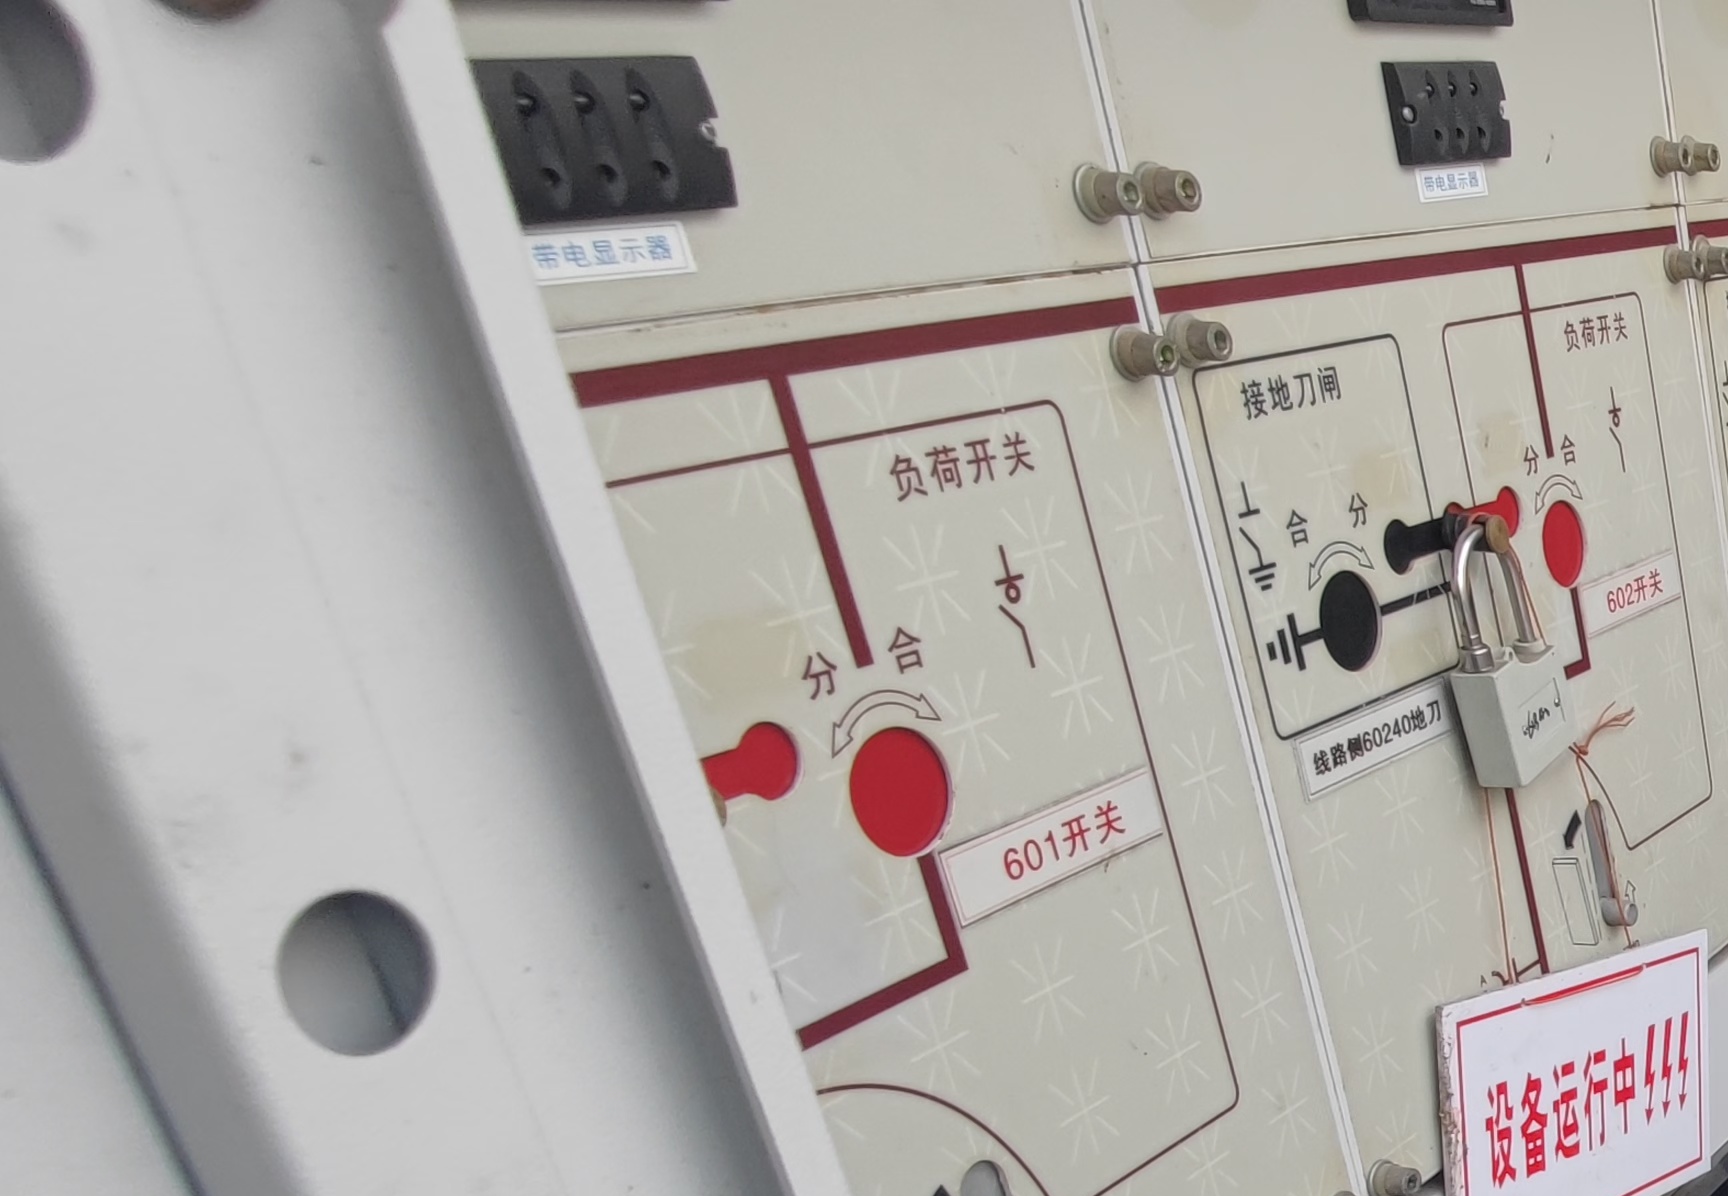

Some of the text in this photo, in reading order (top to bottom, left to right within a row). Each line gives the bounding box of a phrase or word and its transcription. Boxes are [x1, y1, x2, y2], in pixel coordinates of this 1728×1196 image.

[1423, 168, 1480, 195] 带电显示器
[532, 236, 673, 270] 带电显示器
[1563, 312, 1629, 353] 负荷开关
[1240, 366, 1342, 420] 接地刀闸
[889, 433, 1036, 502] 负荷开关
[1523, 445, 1540, 477] 分
[1560, 434, 1576, 466] 合
[1286, 509, 1309, 548] 合
[1348, 492, 1368, 529] 分
[1607, 568, 1664, 614] 602开关
[888, 627, 923, 673] 合
[801, 652, 838, 700] 分
[1313, 699, 1442, 777] 线路侧60240地刀
[1002, 800, 1126, 881] 601开关
[1485, 1036, 1637, 1190] 设备运行中
